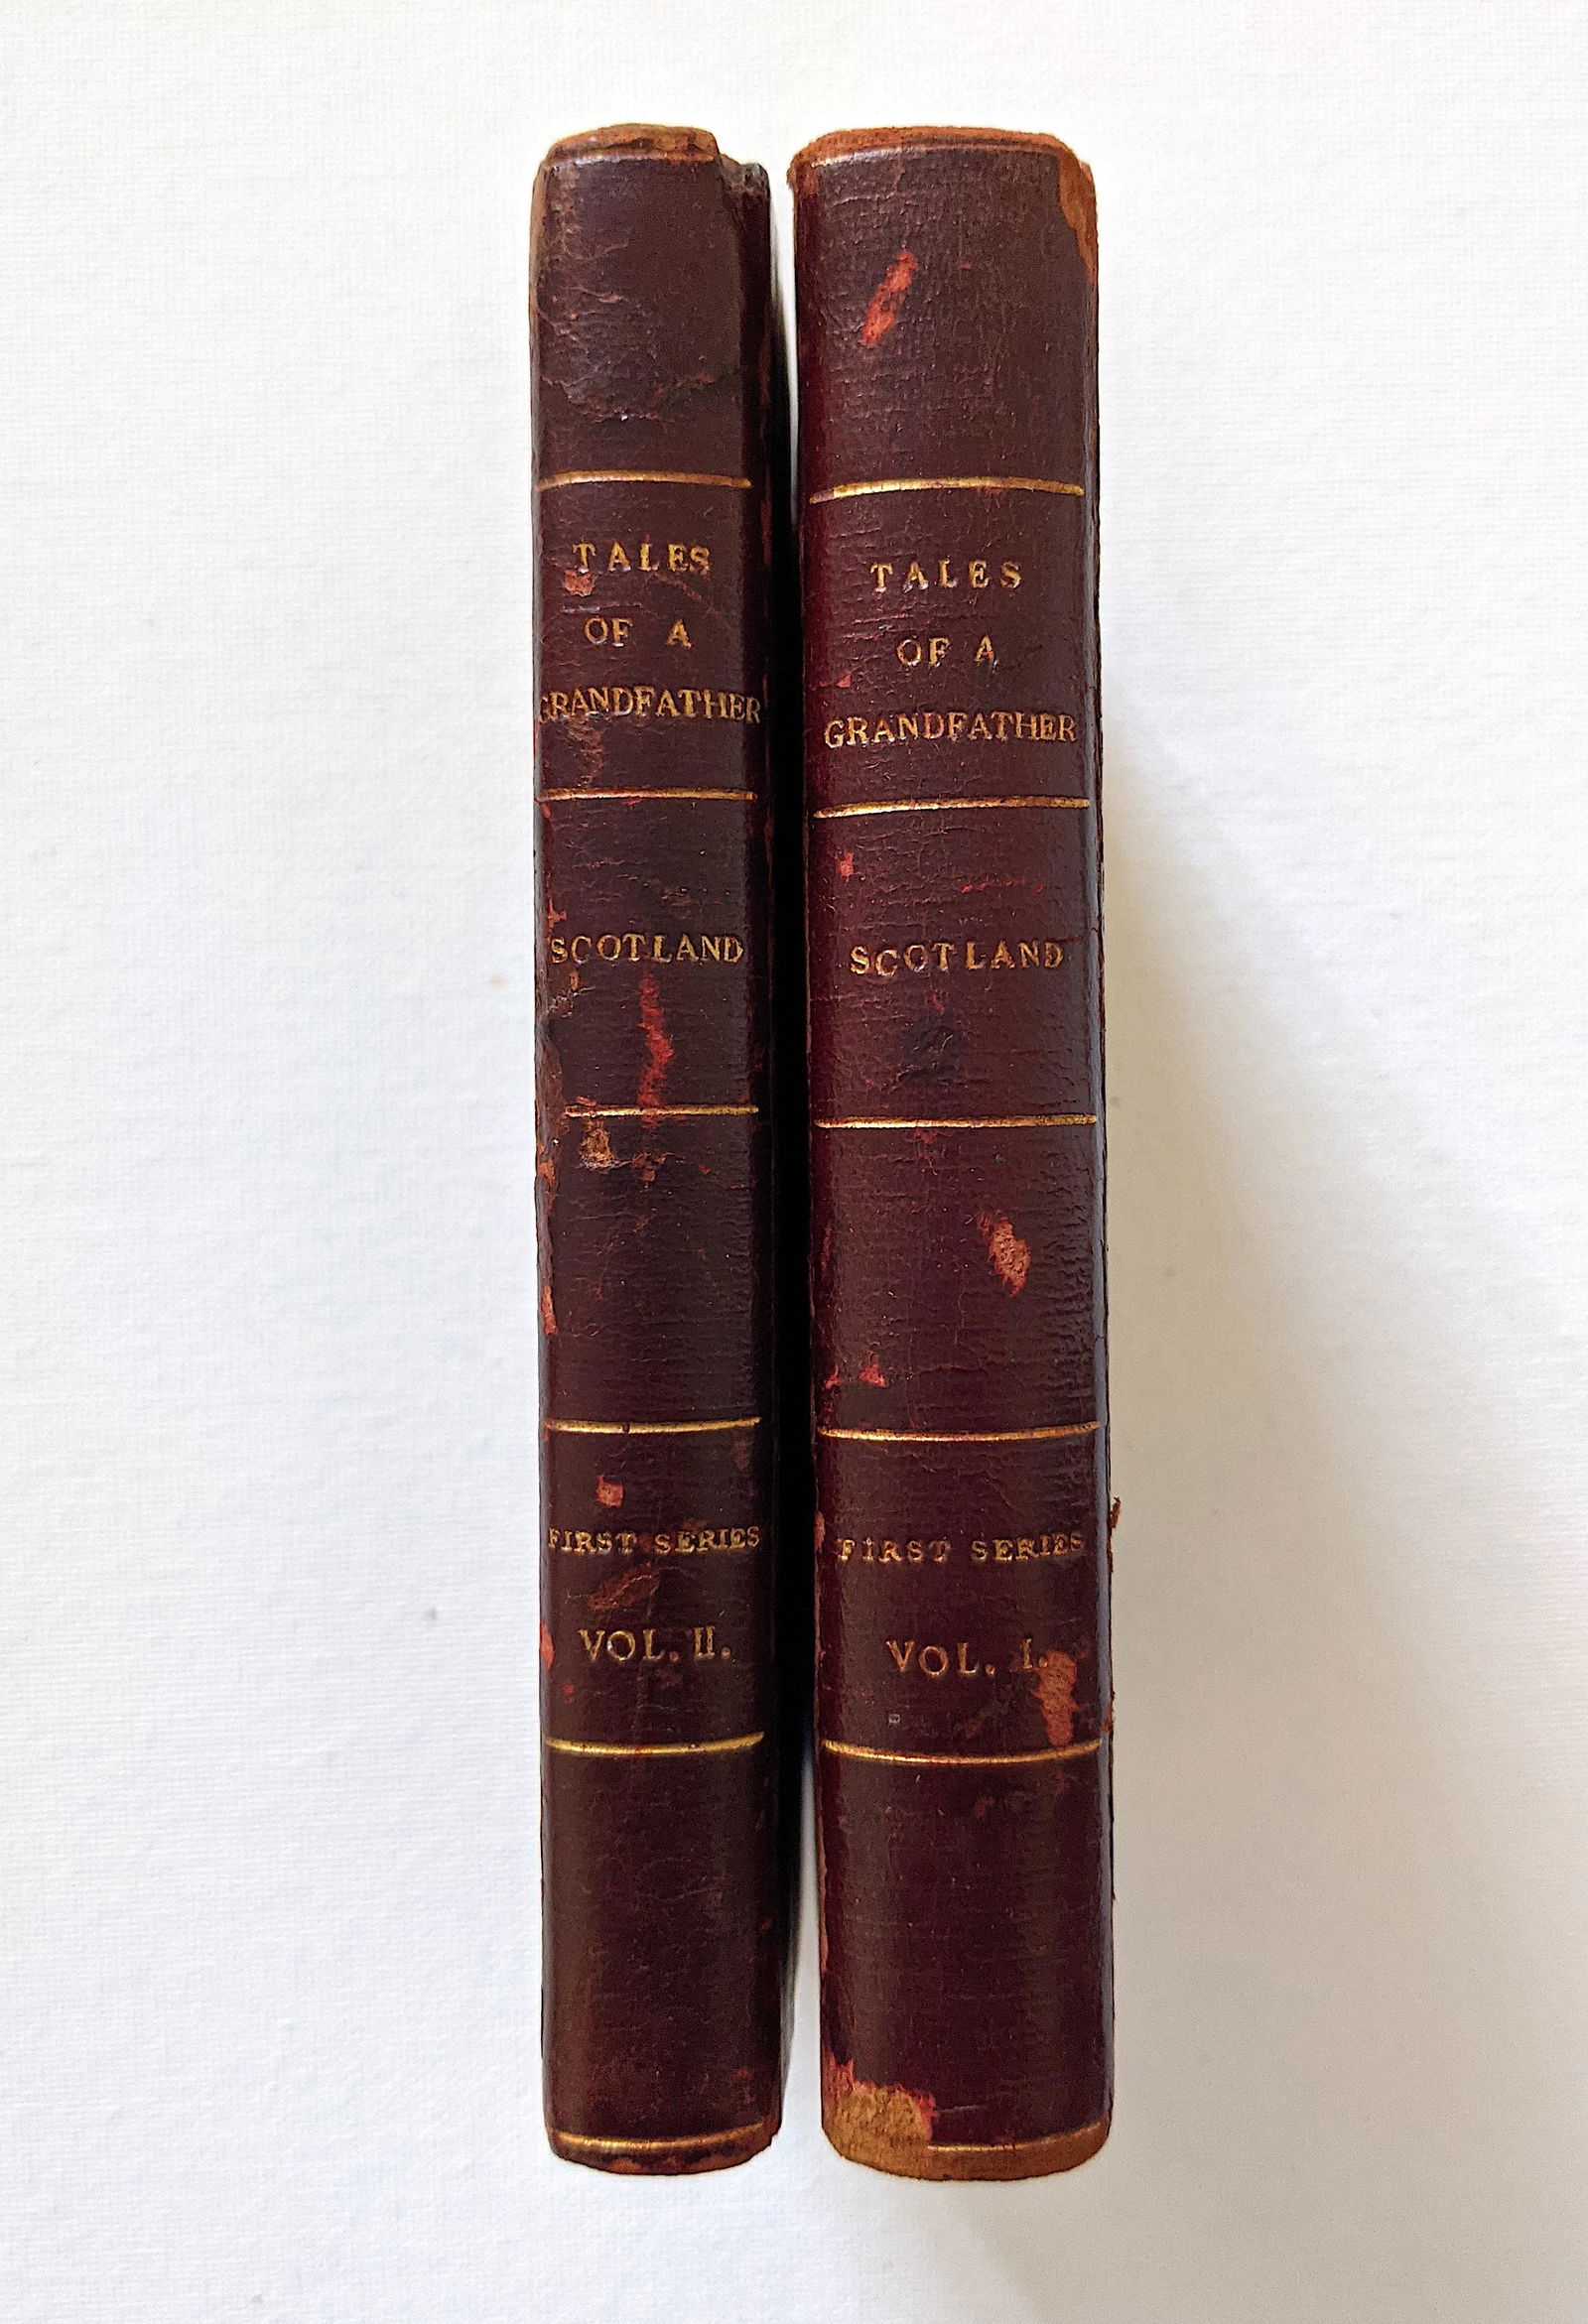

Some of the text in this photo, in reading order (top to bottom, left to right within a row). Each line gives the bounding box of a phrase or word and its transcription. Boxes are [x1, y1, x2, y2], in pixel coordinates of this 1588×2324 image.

[573, 542, 711, 574] TALES
[870, 559, 1023, 594] TALES
[585, 617, 692, 648] OF A
[896, 635, 997, 667] OF A
[824, 710, 1077, 748] GRANDFATHER
[550, 932, 744, 966] SCOTLAND
[850, 940, 1064, 977] SCOTLAND
[547, 1526, 760, 1555] FIRST SERIES
[837, 1532, 1085, 1562] FIRST SERIES
[577, 1625, 731, 1662] VOL. II.
[885, 1638, 1048, 1677] VOL. I.
